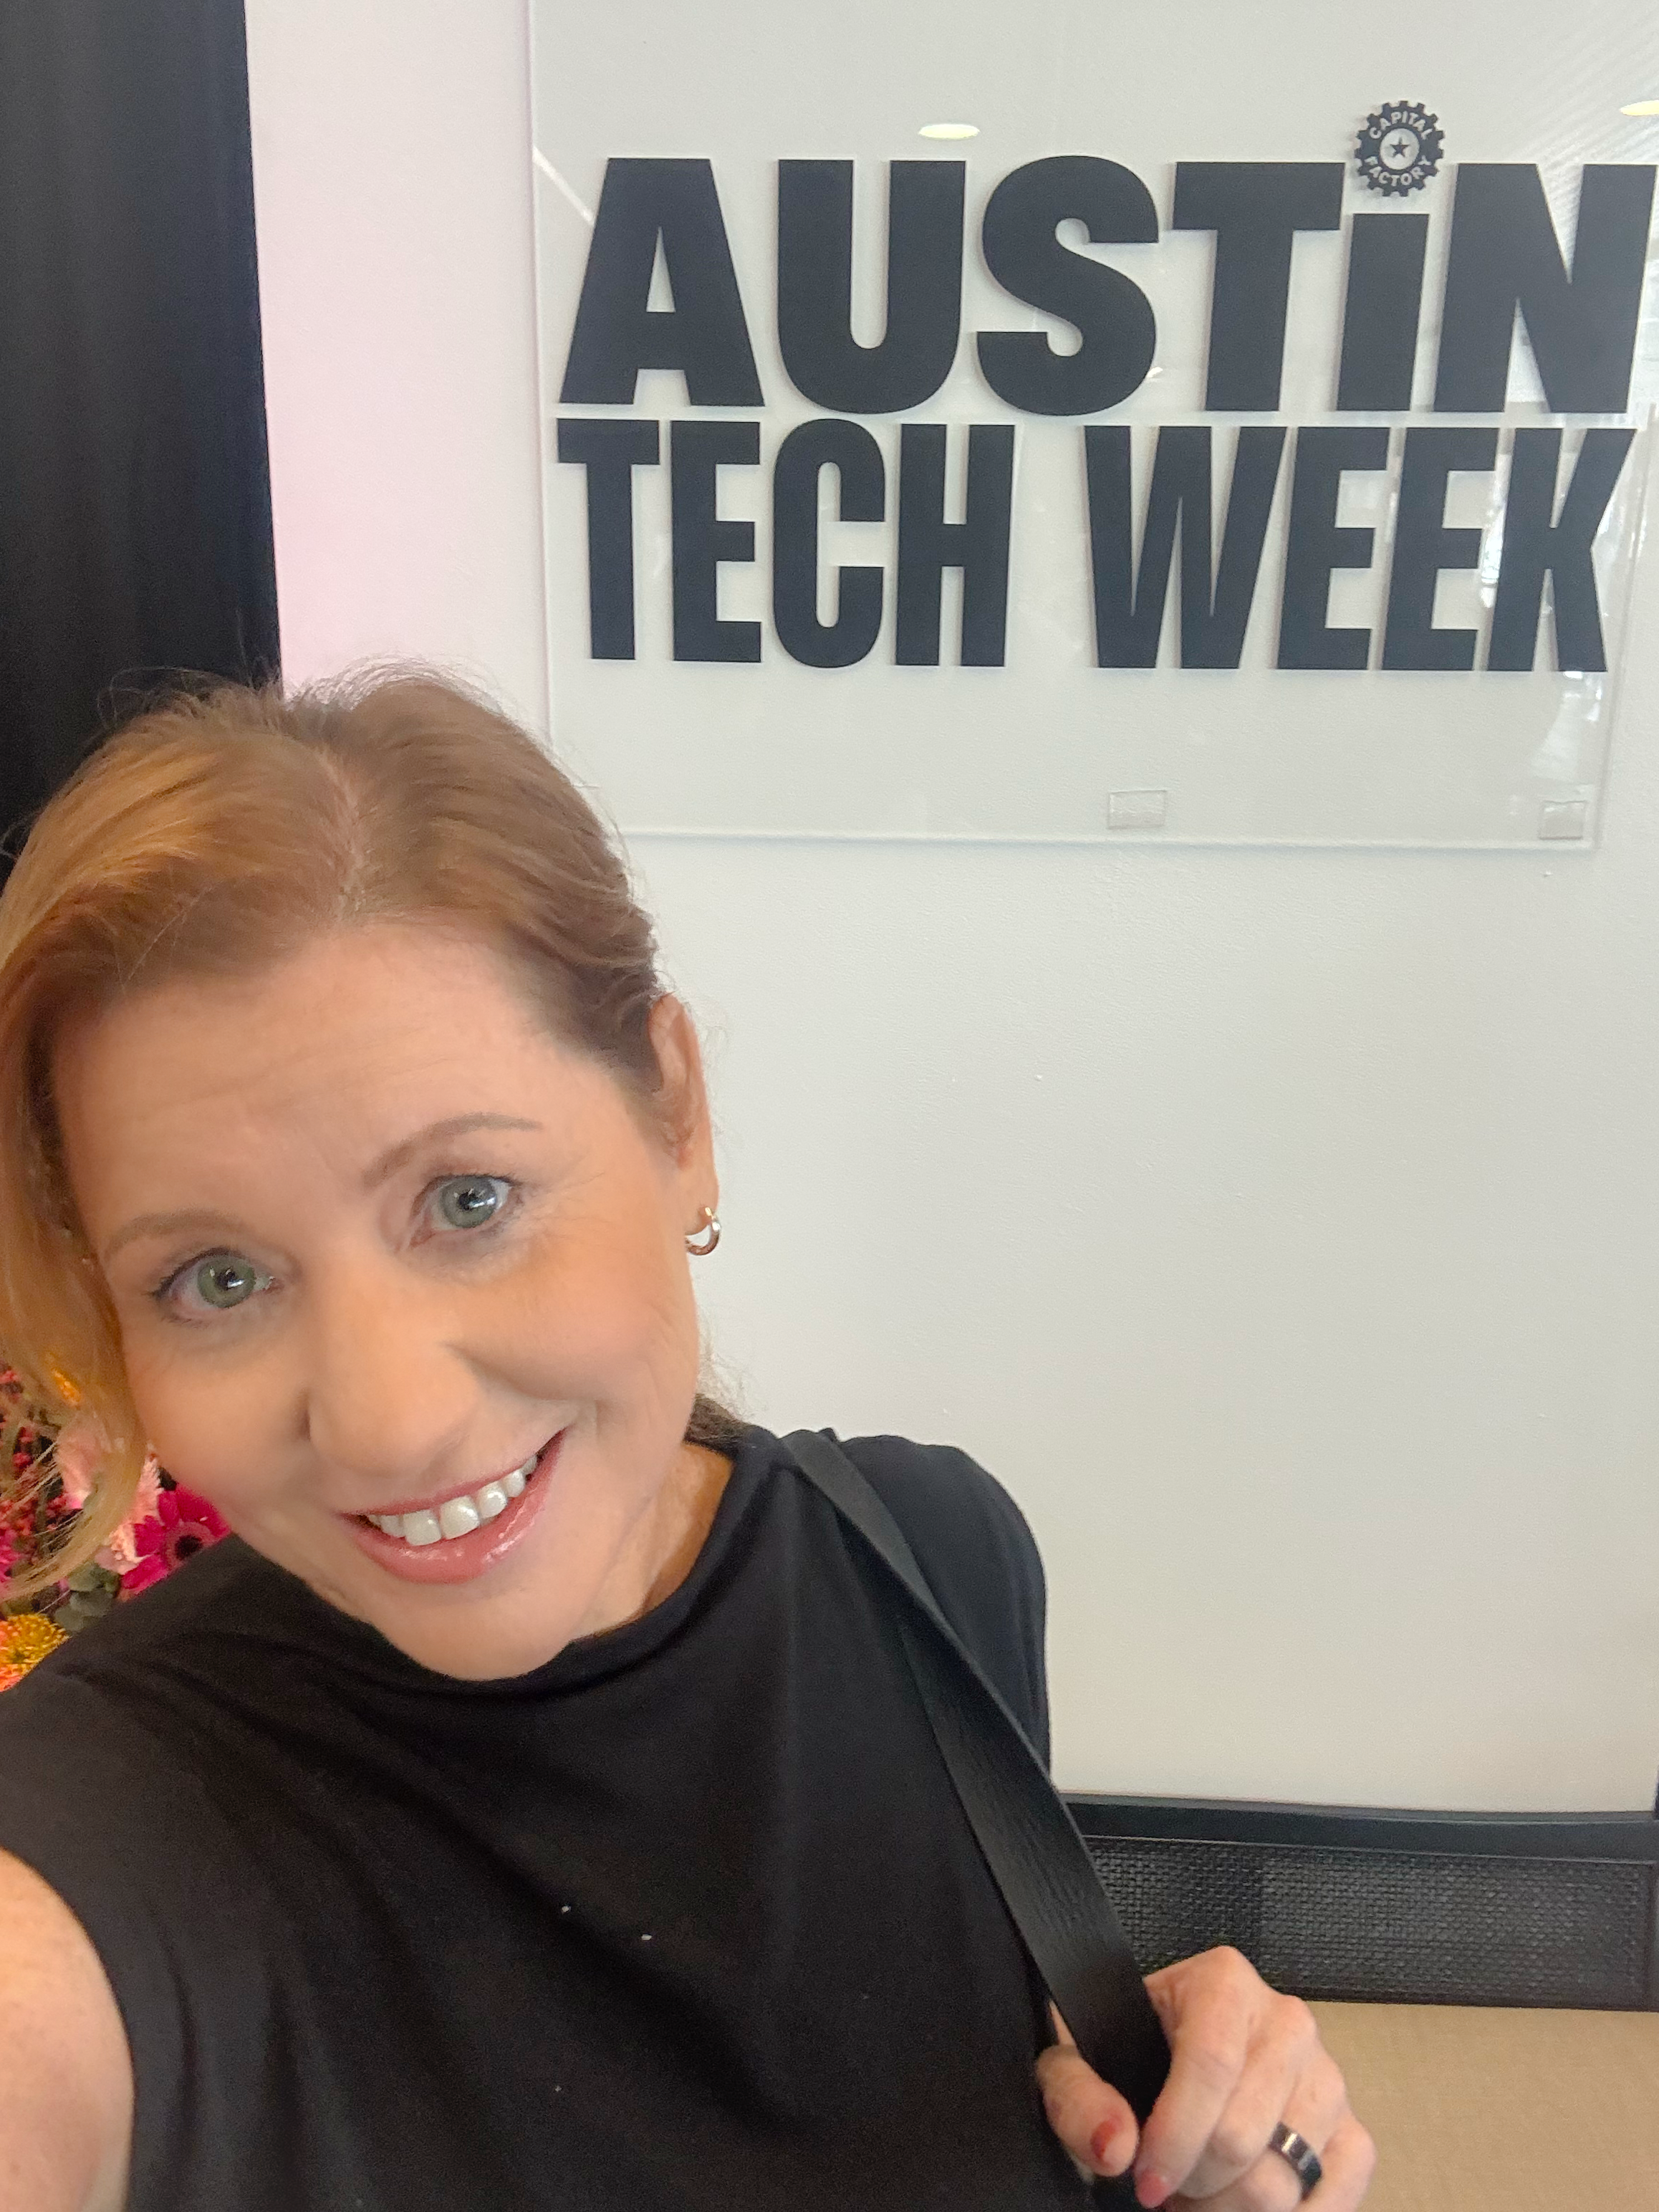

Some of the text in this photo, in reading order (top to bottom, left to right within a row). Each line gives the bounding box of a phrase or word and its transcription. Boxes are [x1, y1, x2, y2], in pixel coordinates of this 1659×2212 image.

[1370, 111, 1433, 140] CAPITAL
[1364, 155, 1431, 186] FACTORY
[557, 418, 1638, 673] TECH WEEK
